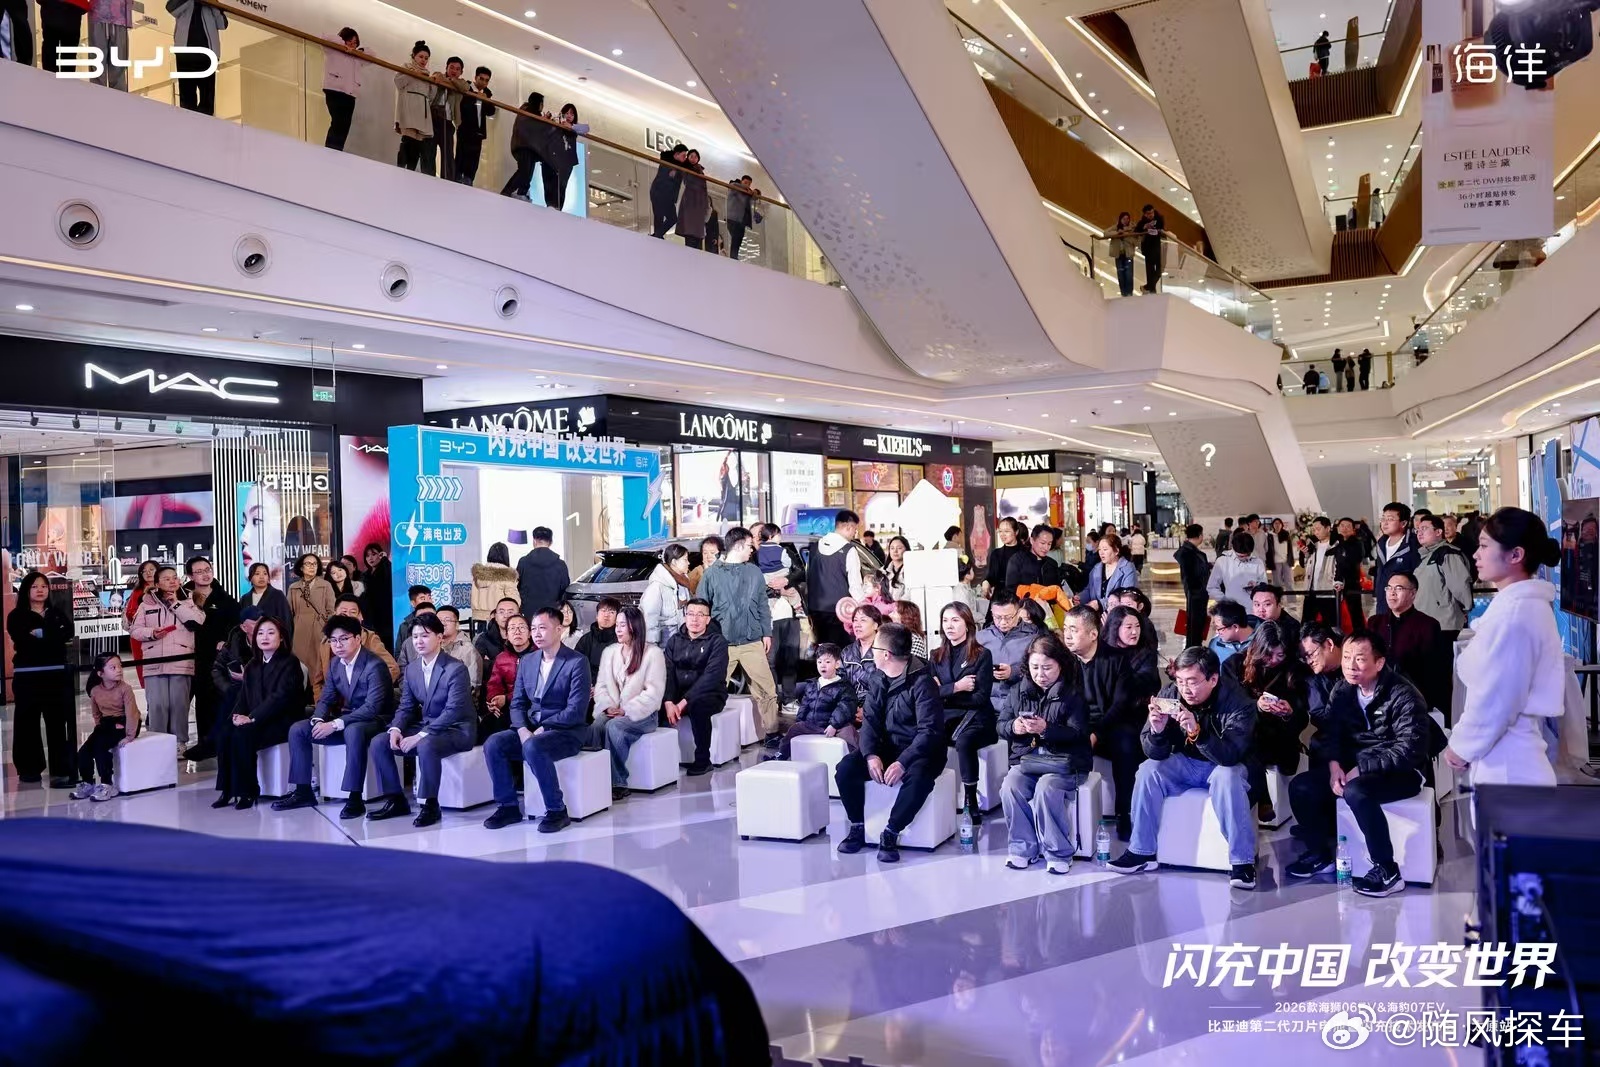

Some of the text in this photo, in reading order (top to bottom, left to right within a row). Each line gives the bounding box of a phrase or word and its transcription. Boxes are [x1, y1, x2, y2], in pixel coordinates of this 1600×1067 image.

[645, 128, 682, 152] LES
[1482, 145, 1530, 158] LAUDER
[1464, 159, 1511, 171] 雅诗兰黛
[680, 412, 758, 442] LANCÔME
[440, 440, 477, 455] BYD
[486, 424, 627, 466] 闪充中国 改变世界
[877, 434, 923, 457] KIEHL'S
[995, 453, 1050, 472] ARMANI
[423, 527, 462, 541] 满电出发
[84, 624, 100, 634] ONLY
[101, 622, 120, 632] WEAR
